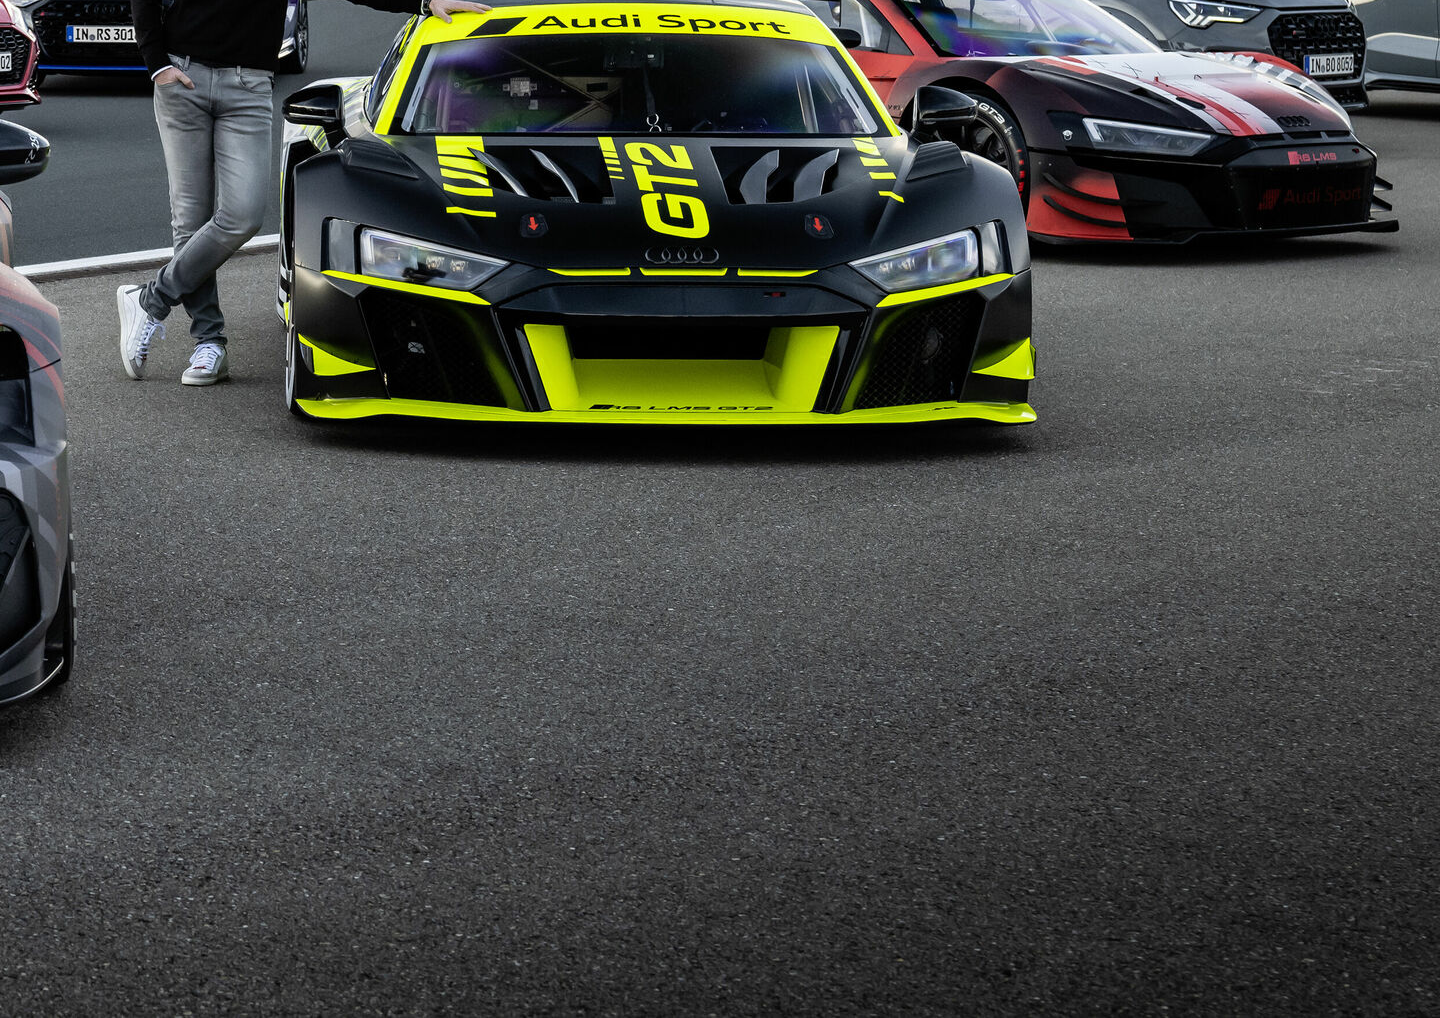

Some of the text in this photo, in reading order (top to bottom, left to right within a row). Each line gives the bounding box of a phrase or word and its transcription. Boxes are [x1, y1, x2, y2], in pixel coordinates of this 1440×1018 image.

[531, 14, 791, 35] Audi Sport
[75, 28, 89, 41] IN
[96, 28, 111, 41] RS
[1310, 58, 1321, 73] IN
[978, 102, 1005, 125] GT3
[1312, 152, 1337, 161] LMS
[624, 142, 710, 239] GT2
[1283, 188, 1321, 207] Audi
